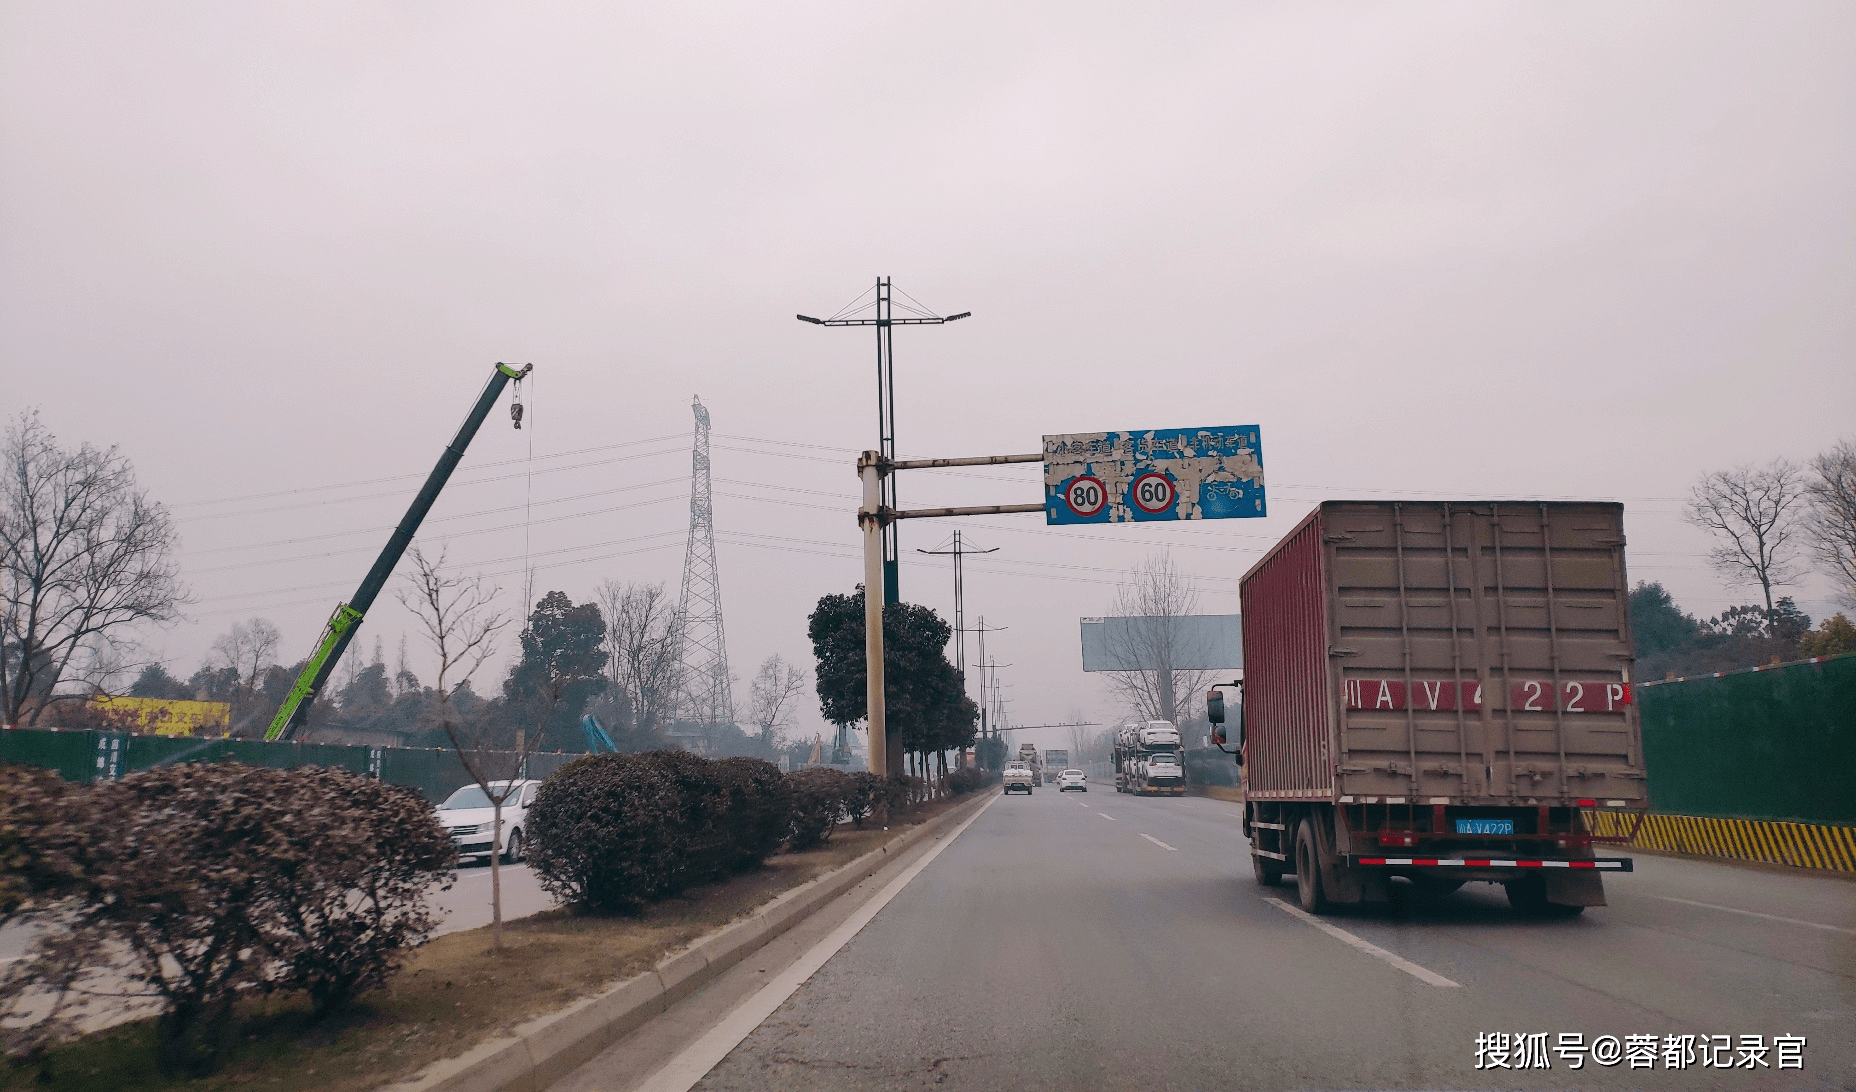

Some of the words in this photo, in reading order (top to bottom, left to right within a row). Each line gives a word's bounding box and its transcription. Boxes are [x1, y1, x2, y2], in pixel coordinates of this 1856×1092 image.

[1189, 433, 1248, 450] 非机动车道
[1073, 486, 1099, 507] 80
[1140, 482, 1167, 503] 60
